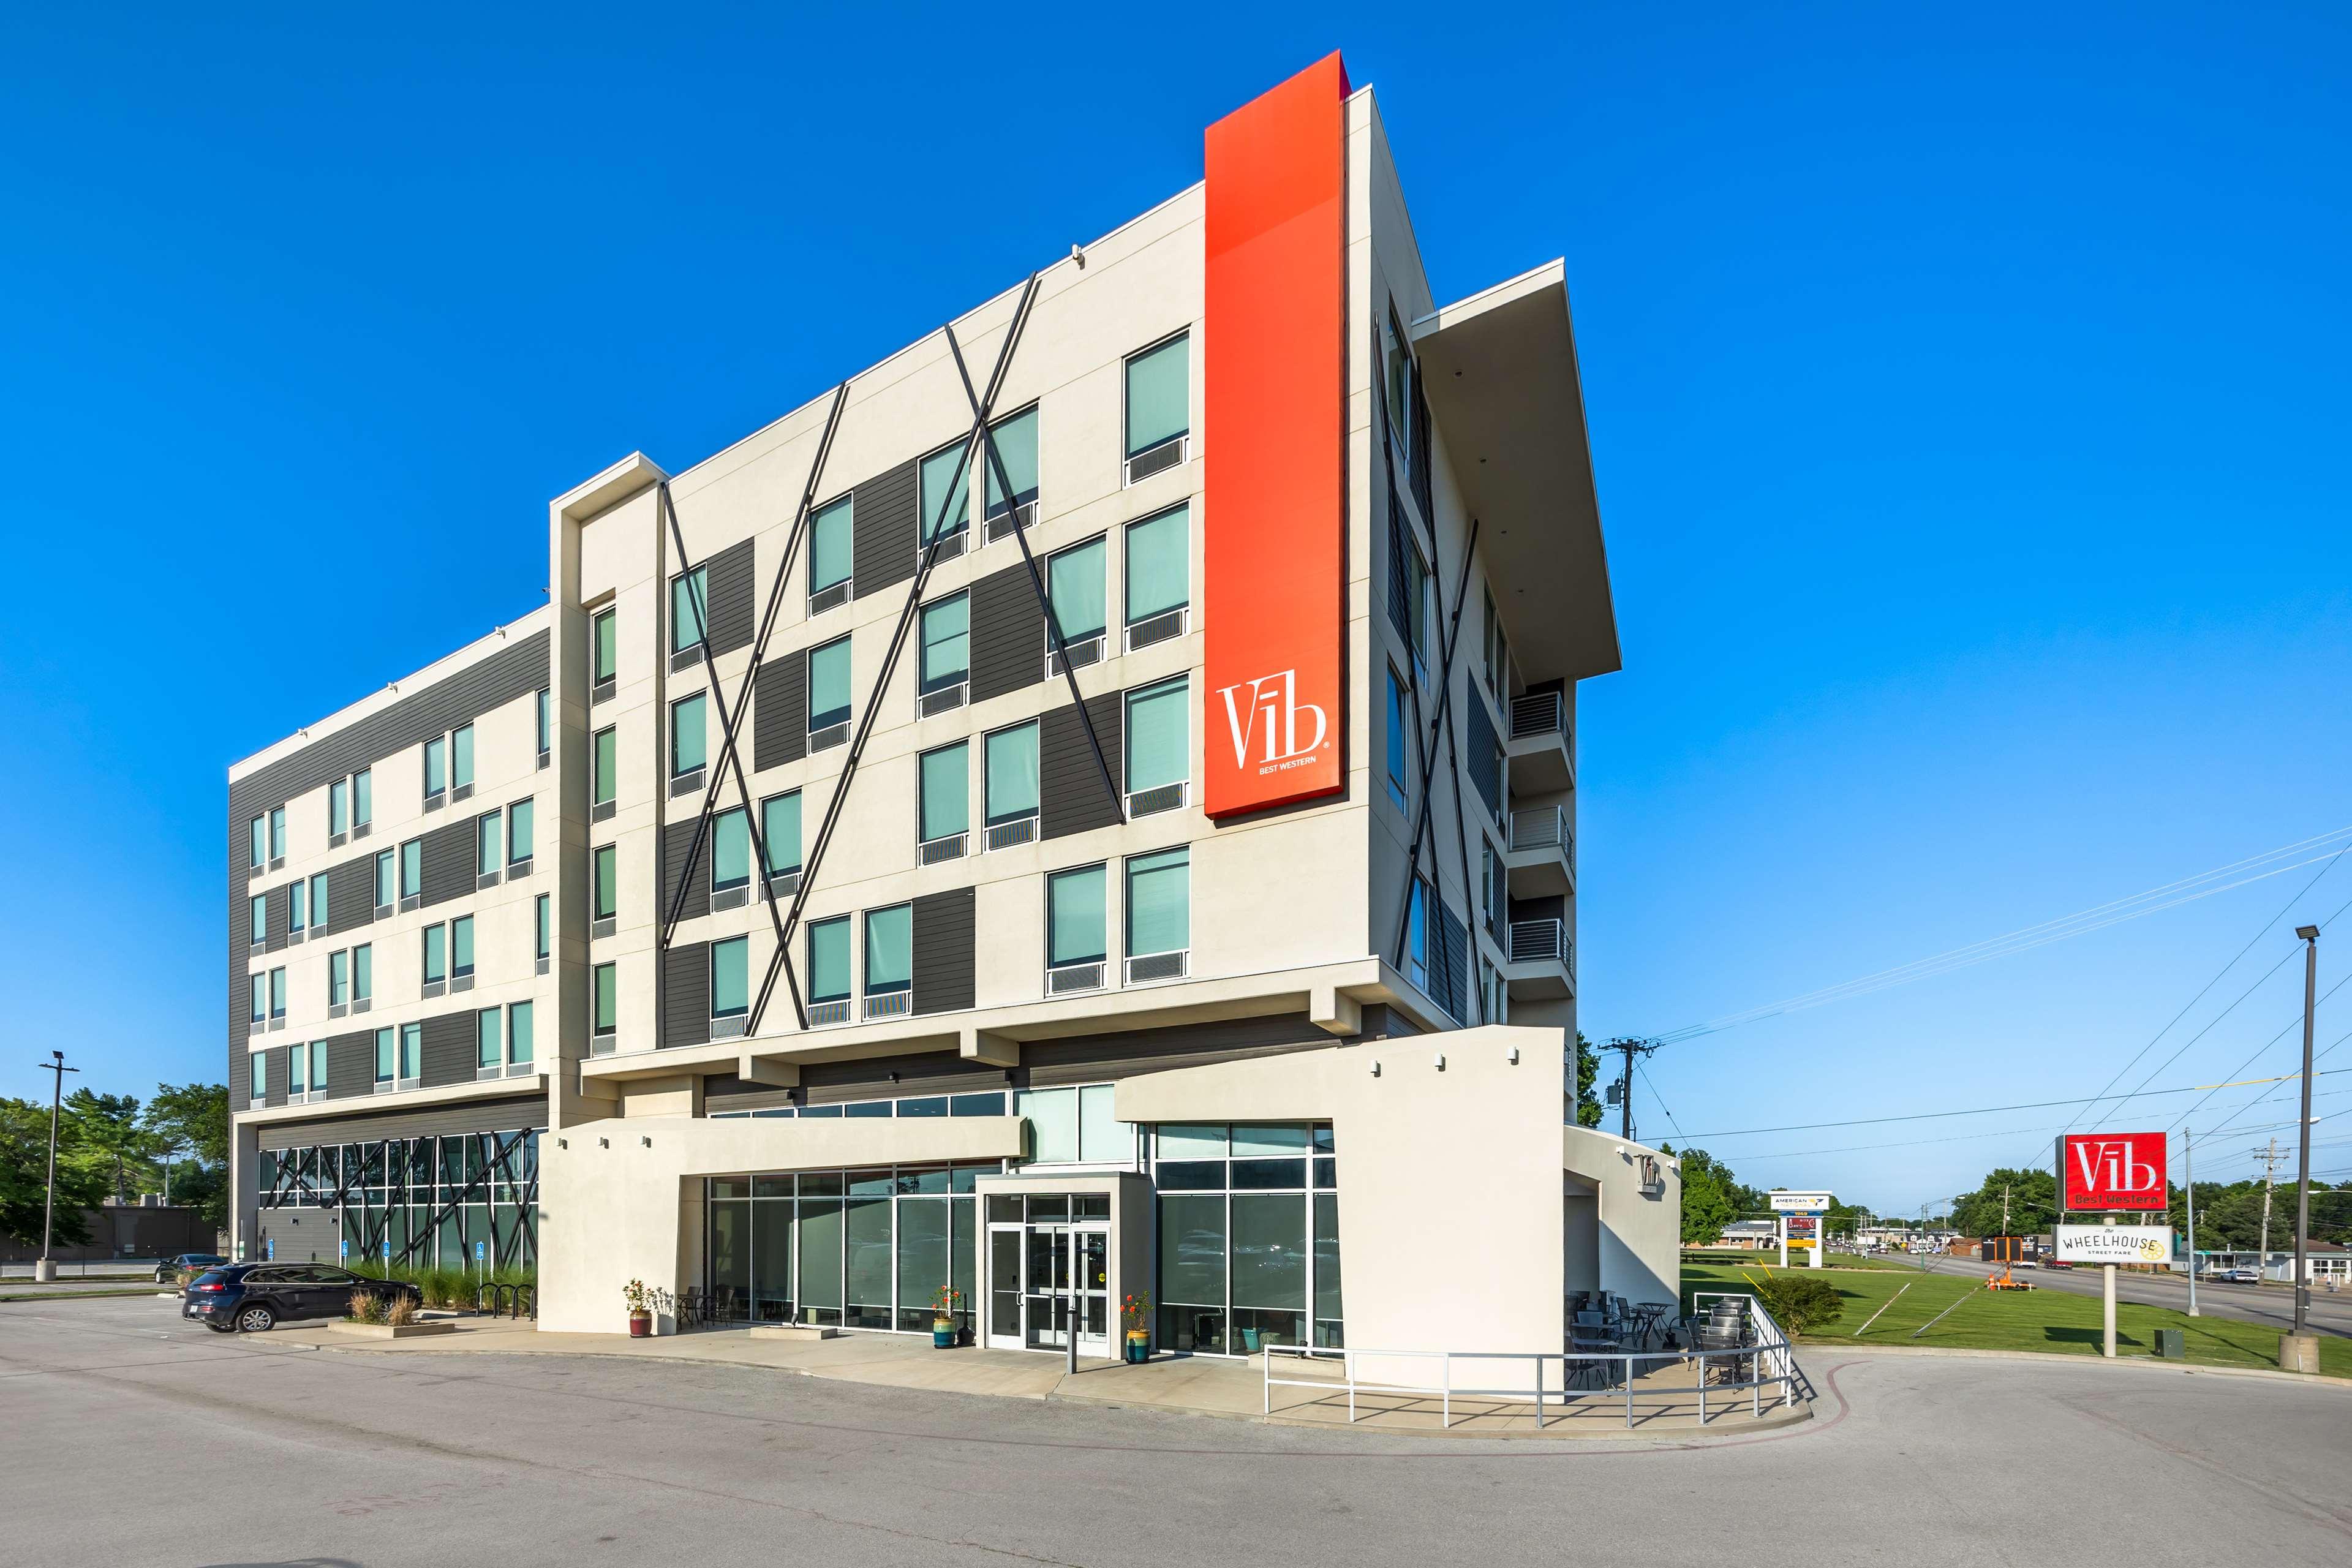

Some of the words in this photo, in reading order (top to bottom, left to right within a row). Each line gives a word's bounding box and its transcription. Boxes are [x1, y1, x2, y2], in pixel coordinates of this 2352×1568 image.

[1216, 669, 1326, 769] Vib
[1260, 764, 1278, 775] BEST
[1280, 756, 1316, 771] WESTERN
[2070, 1142, 2156, 1191] Vib
[2075, 1195, 2102, 1204] Best
[2106, 1195, 2158, 1204] Western
[2063, 1235, 2157, 1251] WHEELHOUSE
